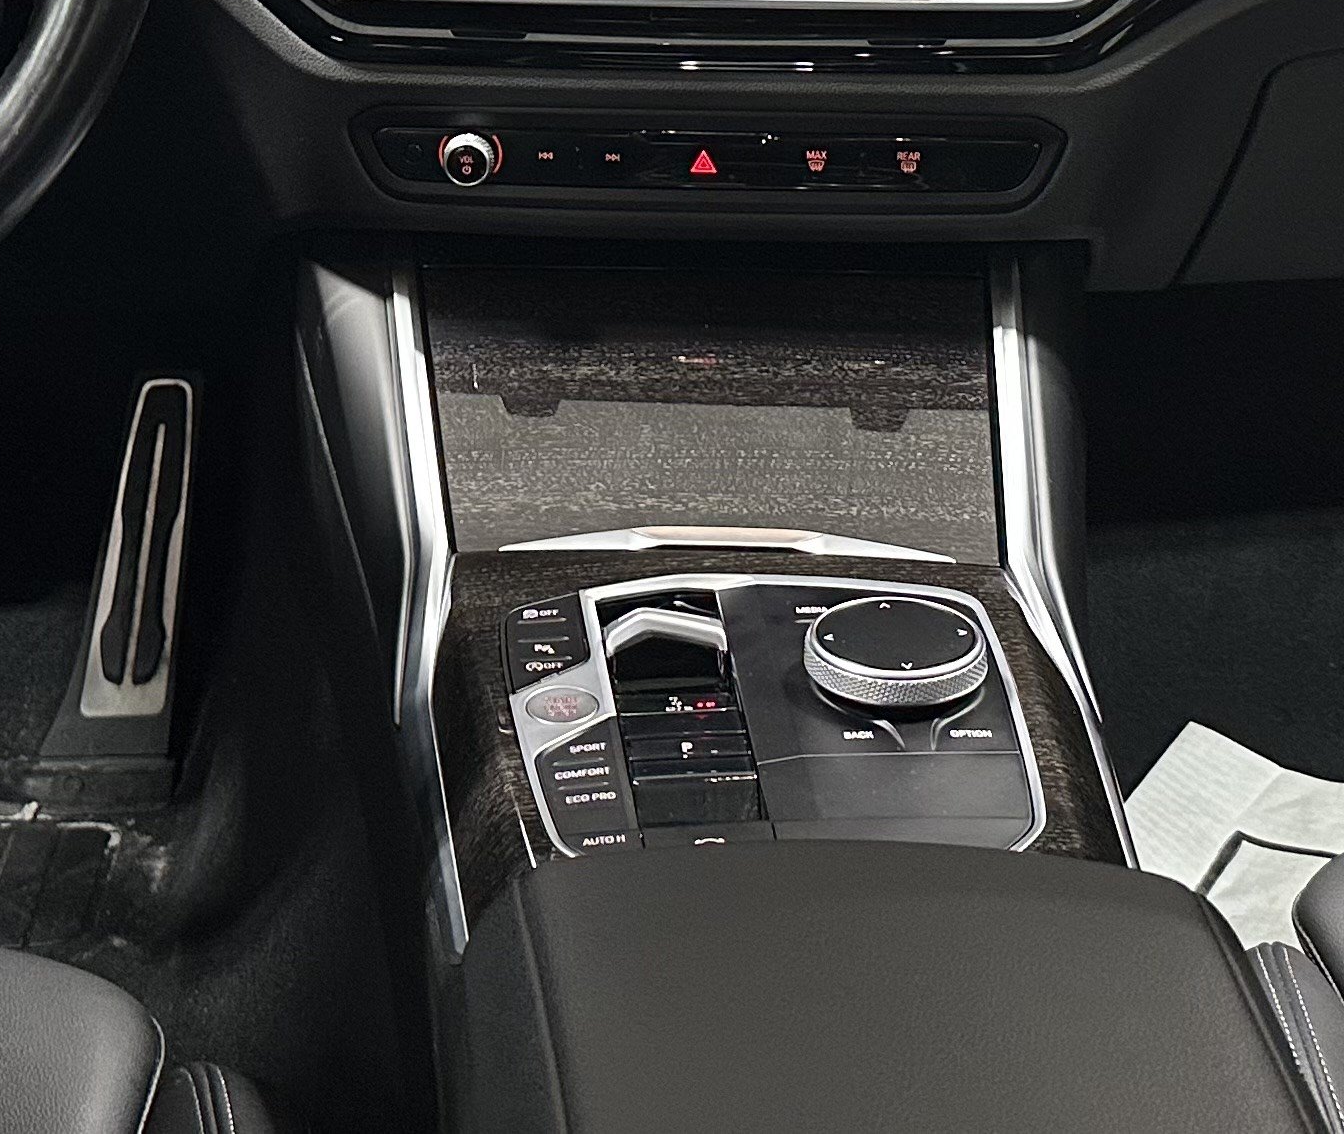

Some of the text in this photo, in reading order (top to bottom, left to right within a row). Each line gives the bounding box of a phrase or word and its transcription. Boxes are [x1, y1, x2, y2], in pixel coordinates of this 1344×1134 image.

[459, 155, 474, 164] VOL
[806, 150, 827, 160] MAX
[896, 151, 921, 162] REAR
[539, 608, 560, 617] OFF
[543, 661, 564, 670] OFF
[843, 730, 875, 740] BACK
[949, 729, 993, 739] OPTION
[569, 742, 607, 754] SPORT
[554, 766, 611, 781] COMFORT
[565, 790, 617, 805] ECO PRO
[582, 833, 626, 847] AUTO H
